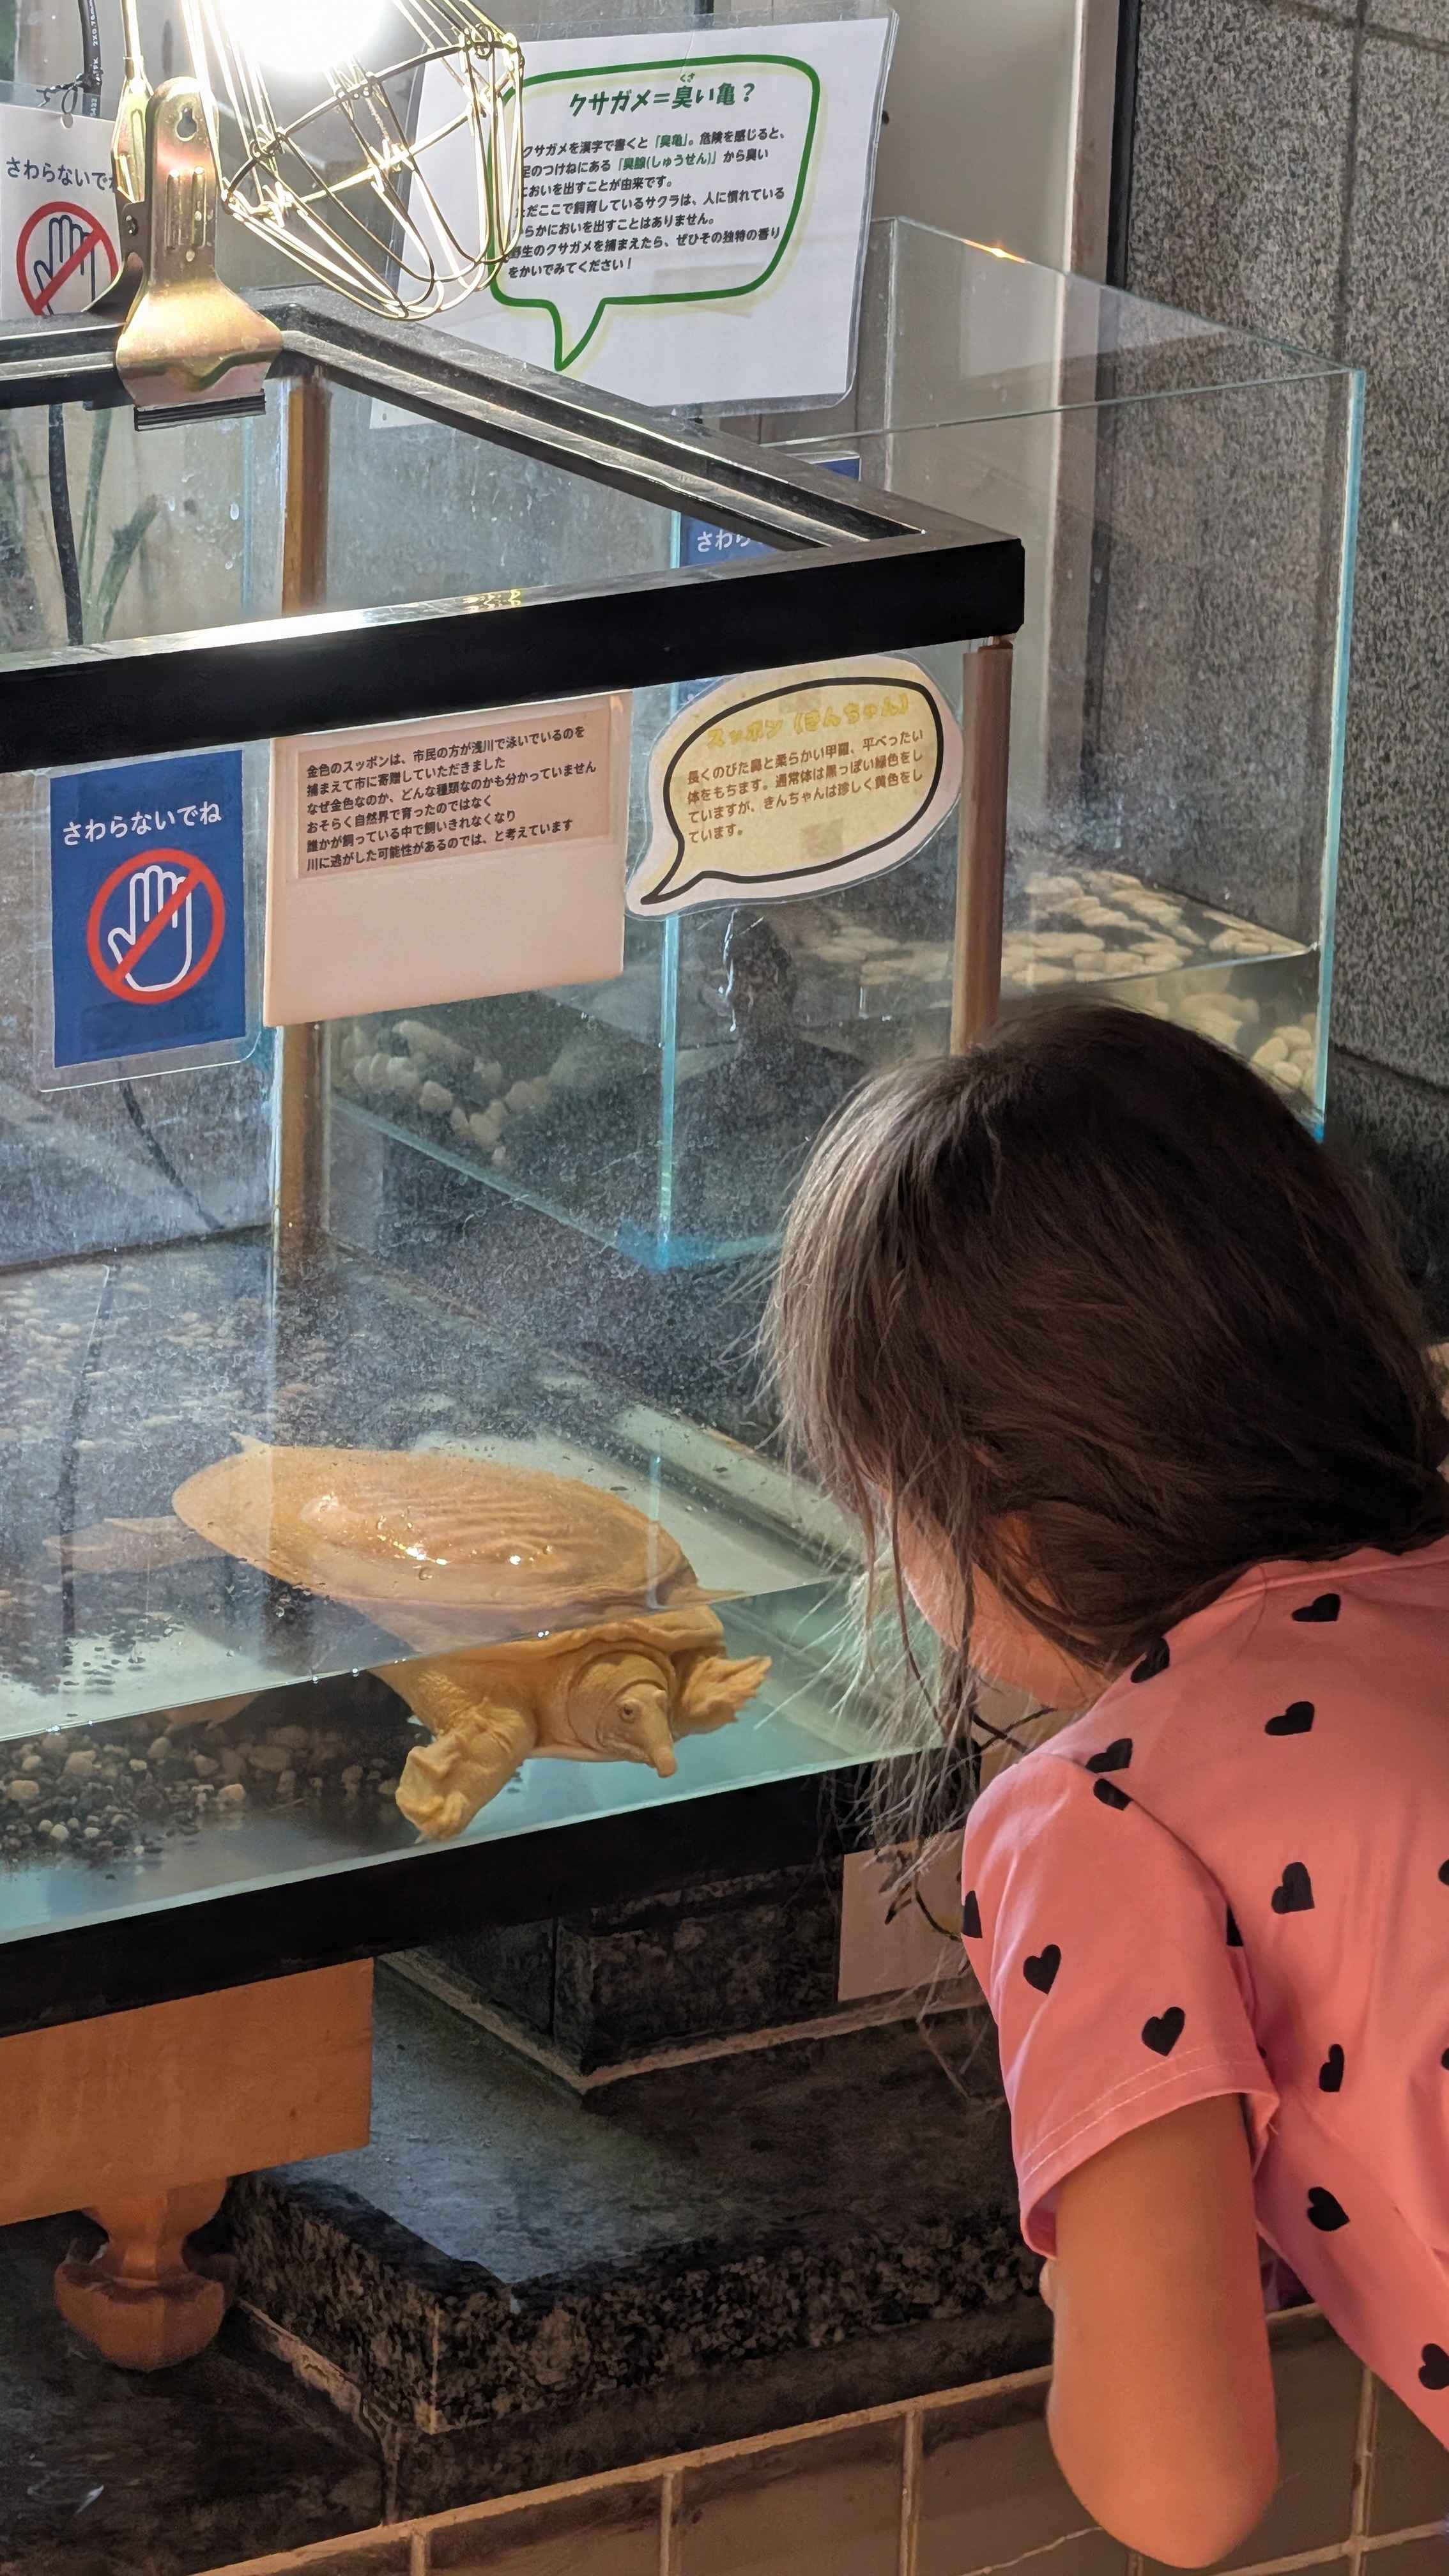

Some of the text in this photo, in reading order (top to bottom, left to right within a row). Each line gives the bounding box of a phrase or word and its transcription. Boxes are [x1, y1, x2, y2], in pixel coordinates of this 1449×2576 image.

[679, 72, 695, 82] くさ
[570, 82, 755, 117] クサガメ＝臭い亀？
[513, 212, 714, 238] らかにおいを出すことはありません。
[307, 756, 506, 798] 捕まえて市に寄贈していただきました
[687, 730, 923, 785] 長くのびた鼻と柔らかい甲羅、平べったい
[307, 761, 597, 816] なぜ金色なのか、どんな種類なのかも分かっていません
[688, 769, 923, 824] ていますが、きんちゃんは珍しく黄色をし
[63, 801, 222, 846] さわらないでね
[307, 794, 491, 834] おそらく自然界で育ったのではなく
[307, 809, 516, 854] 誰かが飼っている中で飼いきれなくなり
[688, 823, 743, 843] ています。
[307, 818, 573, 871] 川に逃がした可能性があるのでは、と考えています
